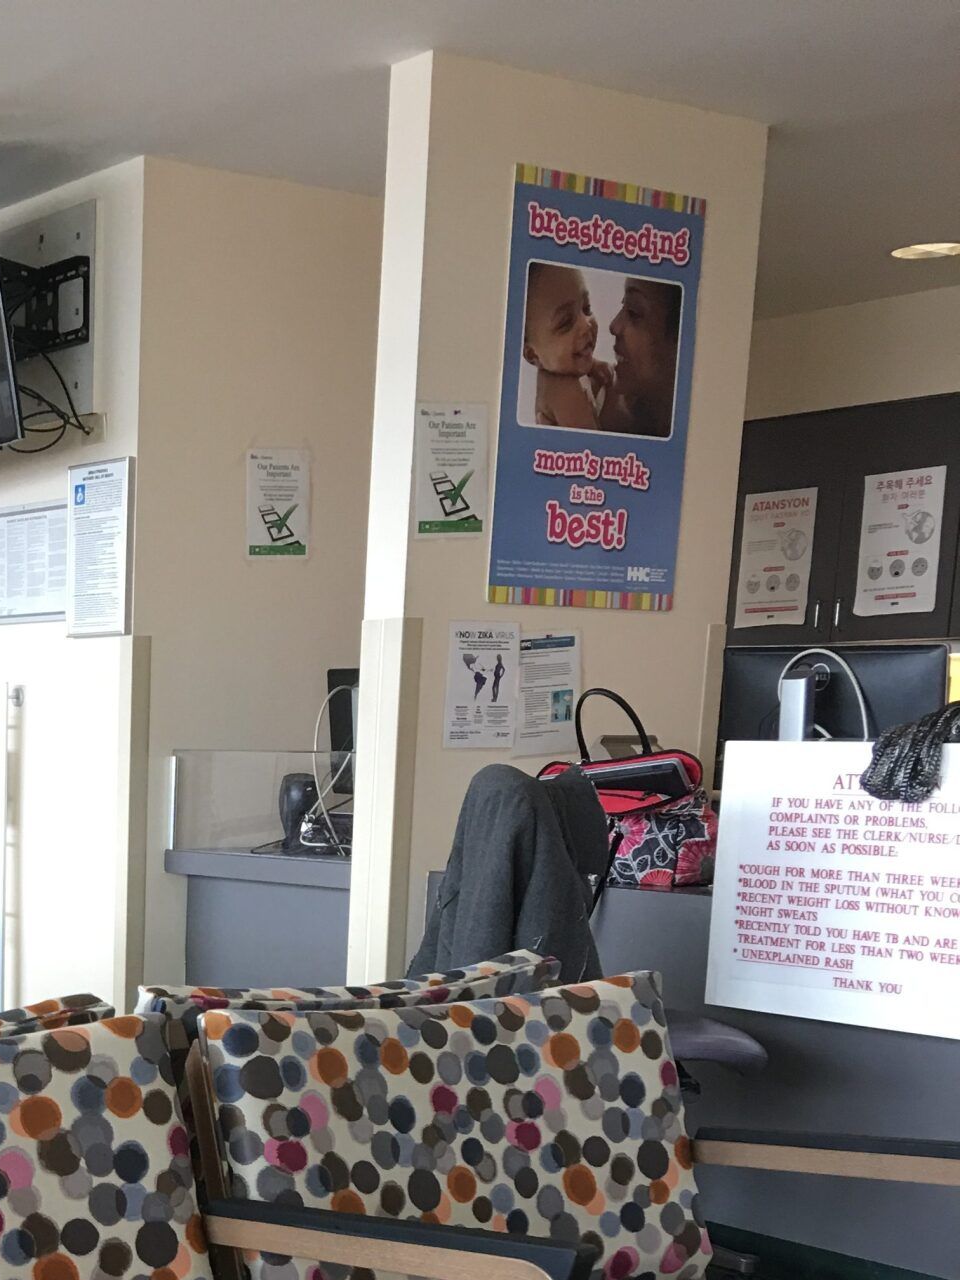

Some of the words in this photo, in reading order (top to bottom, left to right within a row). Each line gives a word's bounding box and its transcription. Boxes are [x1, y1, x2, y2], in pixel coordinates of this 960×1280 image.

[528, 202, 690, 264] breastfeeding
[535, 450, 599, 478] mom's
[602, 453, 649, 488] milk
[571, 485, 581, 501] is
[584, 487, 603, 503] the
[752, 497, 810, 512] ATANSYON
[547, 501, 627, 548] best!
[455, 631, 476, 639] KNOW
[477, 631, 494, 639] ZIKA
[495, 631, 515, 639] VIRUS
[771, 797, 783, 807] IF
[787, 798, 809, 808] YOU
[815, 799, 843, 809] HAVE
[848, 800, 873, 811] ANY
[879, 801, 894, 811] OF
[901, 802, 922, 812] THE
[929, 802, 960, 814] FOLL
[769, 812, 840, 824] COMPLAINTS
[844, 815, 859, 825] OR
[865, 816, 928, 829] PROBLEMS,
[768, 826, 808, 837] PLEASE
[812, 827, 831, 838] SEE
[837, 829, 858, 840] THE
[766, 840, 781, 850] AS
[785, 841, 816, 852] SOON
[821, 843, 836, 853] AS
[785, 867, 805, 877] FOR
[811, 868, 842, 880] MORE
[847, 871, 880, 882] THAN
[886, 873, 925, 886] THREE
[780, 881, 793, 890] IN
[799, 882, 820, 893] THE
[824, 884, 871, 896] SPUTUM
[875, 887, 914, 900] (WHAT
[920, 890, 944, 902] YOU
[787, 896, 831, 908] WEIGHT
[835, 899, 860, 911] LOSS
[865, 901, 919, 915] WITHOUT
[777, 909, 818, 921] SWEATS
[794, 924, 821, 936] TOLD
[826, 928, 848, 939] YOU
[852, 930, 880, 942] HAVE
[885, 933, 899, 944] TB
[903, 935, 930, 947] AND
[934, 938, 957, 949] ARE
[737, 933, 801, 949] TREATMENT
[805, 940, 826, 951] FOR
[831, 943, 856, 954] LESS
[860, 945, 893, 958] THAN
[898, 949, 924, 961] TWO
[741, 948, 820, 966] UNEXPLAINED
[824, 957, 854, 970] RASH
[832, 977, 873, 991] THANK
[878, 982, 903, 994] YOU
